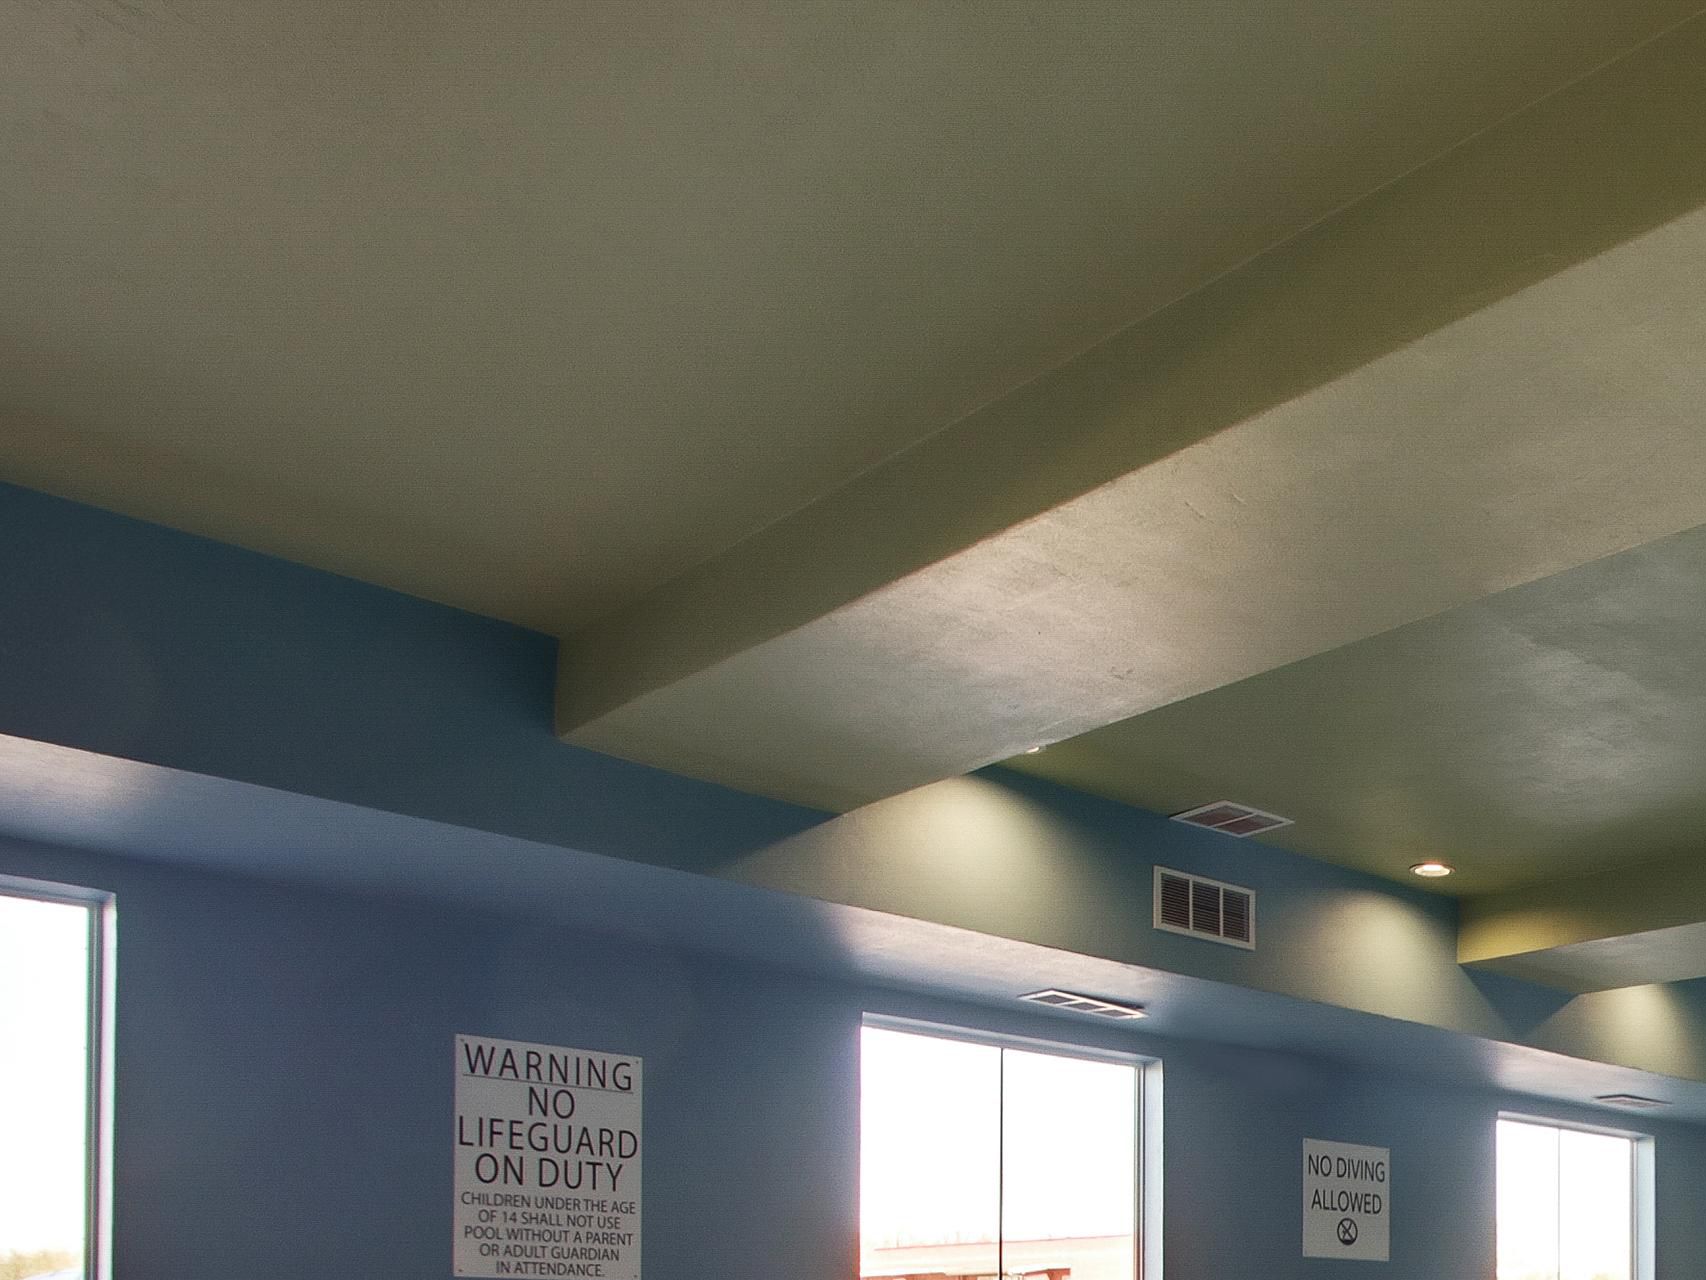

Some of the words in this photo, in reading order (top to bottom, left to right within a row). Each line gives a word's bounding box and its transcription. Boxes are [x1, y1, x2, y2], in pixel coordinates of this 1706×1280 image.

[464, 1043, 632, 1091] WARNING
[529, 1086, 575, 1119] NO
[459, 1115, 638, 1159] LIFEGUARD
[475, 1153, 524, 1185] ON
[539, 1157, 623, 1192] DUTY
[1308, 1153, 1332, 1177] NO
[1336, 1157, 1385, 1182] DIVING
[461, 1191, 531, 1208] CHILDREN
[535, 1195, 581, 1211] UNDER
[583, 1199, 607, 1213] THE
[611, 1200, 636, 1215] AGE
[1311, 1188, 1382, 1214] ALLOWED
[478, 1209, 497, 1223] OF
[503, 1211, 517, 1224] 14
[521, 1211, 563, 1227] SHALL
[567, 1215, 594, 1228] NOT
[597, 1216, 621, 1230] USE
[464, 1225, 505, 1240] POOL
[506, 1228, 570, 1243] WITHOUT
[573, 1231, 582, 1243] A
[586, 1231, 633, 1246] PARENT
[479, 1243, 500, 1257] OR
[503, 1245, 549, 1259] ADULT
[551, 1246, 620, 1261] GUARDIAN
[496, 1261, 511, 1274] IN
